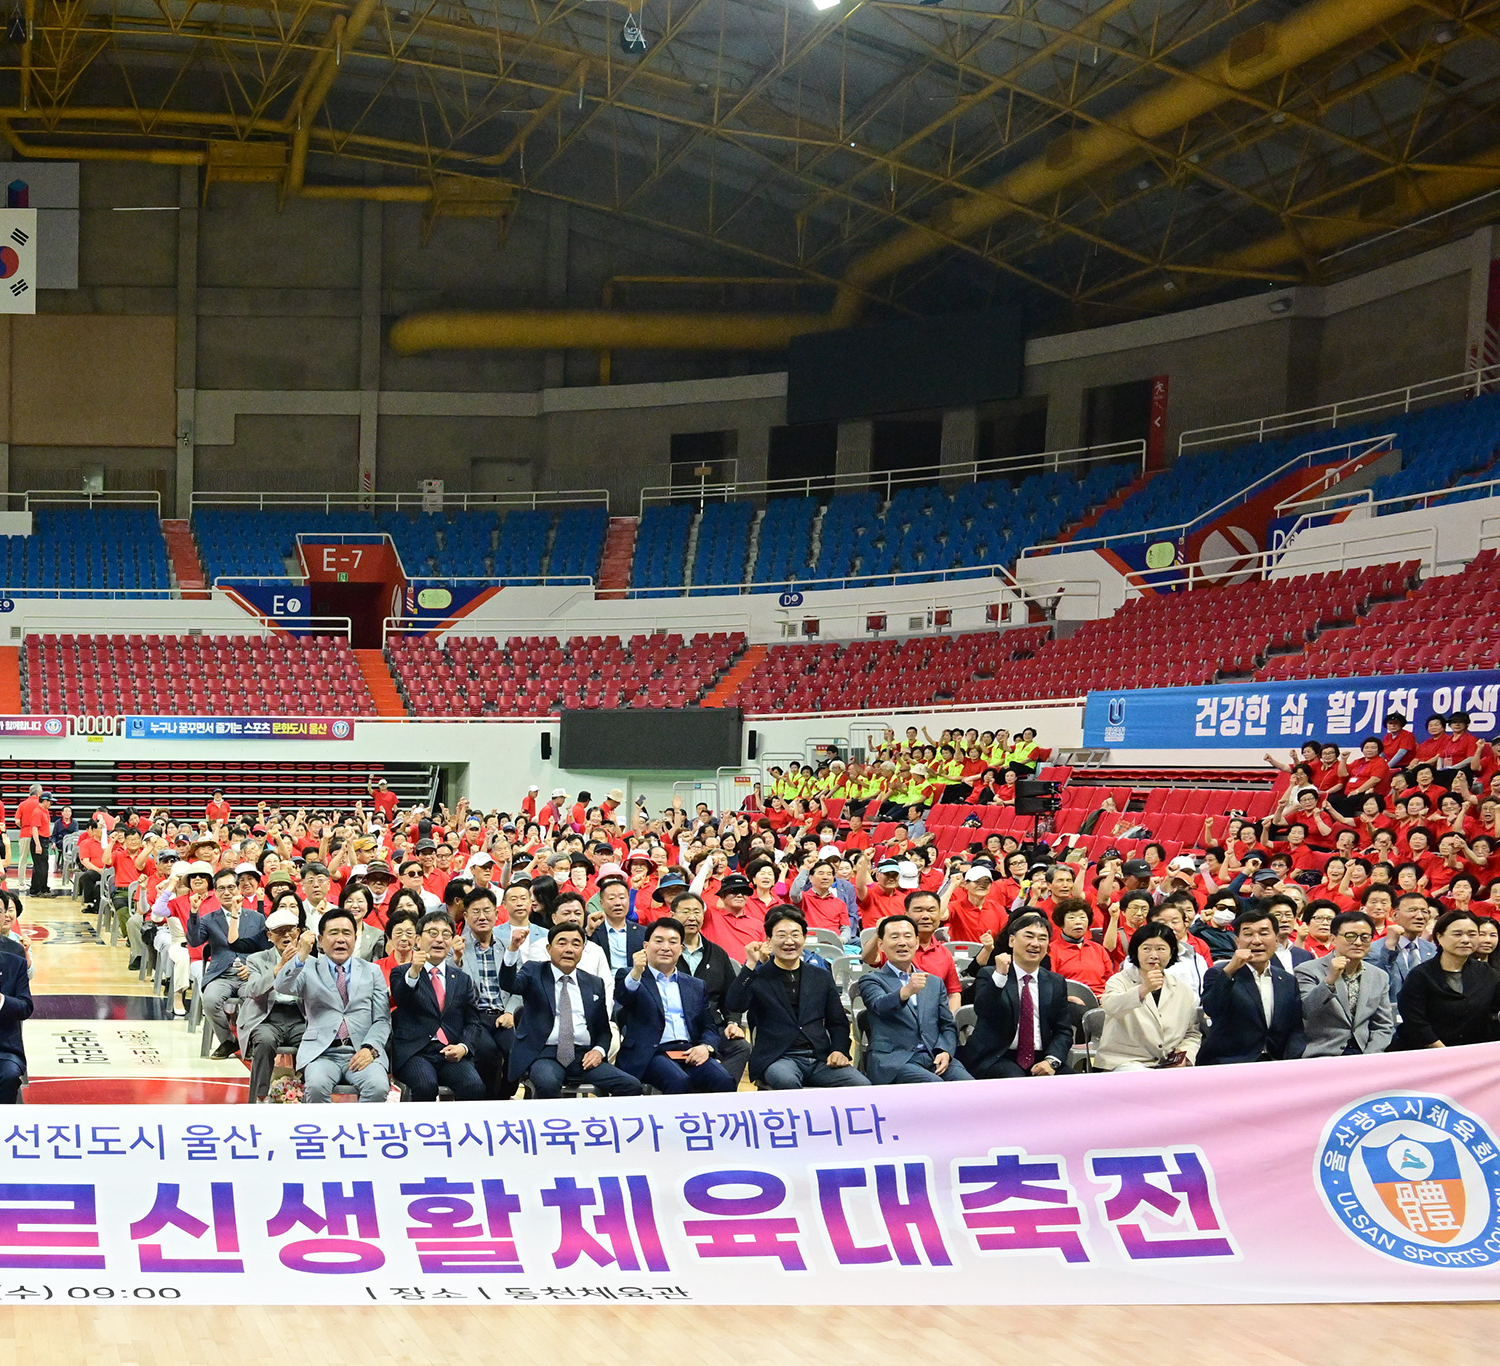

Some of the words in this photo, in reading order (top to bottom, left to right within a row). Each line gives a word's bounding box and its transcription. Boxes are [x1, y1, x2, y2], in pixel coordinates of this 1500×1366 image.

[323, 548, 363, 572] E-7
[150, 722, 177, 733] 누구나
[178, 722, 214, 734] 꿈꾸면서
[215, 722, 242, 734] 즐기는
[244, 723, 270, 734] 스포츠
[272, 723, 307, 734] 문화도시
[309, 723, 327, 735] 울산
[1195, 696, 1270, 736] 건강한
[1280, 693, 1314, 737] 삶,
[1326, 687, 1419, 735] 활기찬
[1432, 684, 1500, 732] 인생
[4, 1123, 166, 1160] 선진도시
[181, 1123, 274, 1162] 울산,
[289, 1113, 663, 1161] 울산광역시체육회가
[674, 1103, 899, 1150] 함께합니다.
[1324, 1099, 1498, 1173] 울산광역시체육회
[1337, 1192, 1397, 1251] ULSAN
[1402, 1244, 1490, 1267] SPORTS
[1395, 1180, 1461, 1233] 體
[67, 1286, 182, 1299] 09:00
[389, 1286, 468, 1301] 장소
[504, 1286, 693, 1300] 동천체육관
